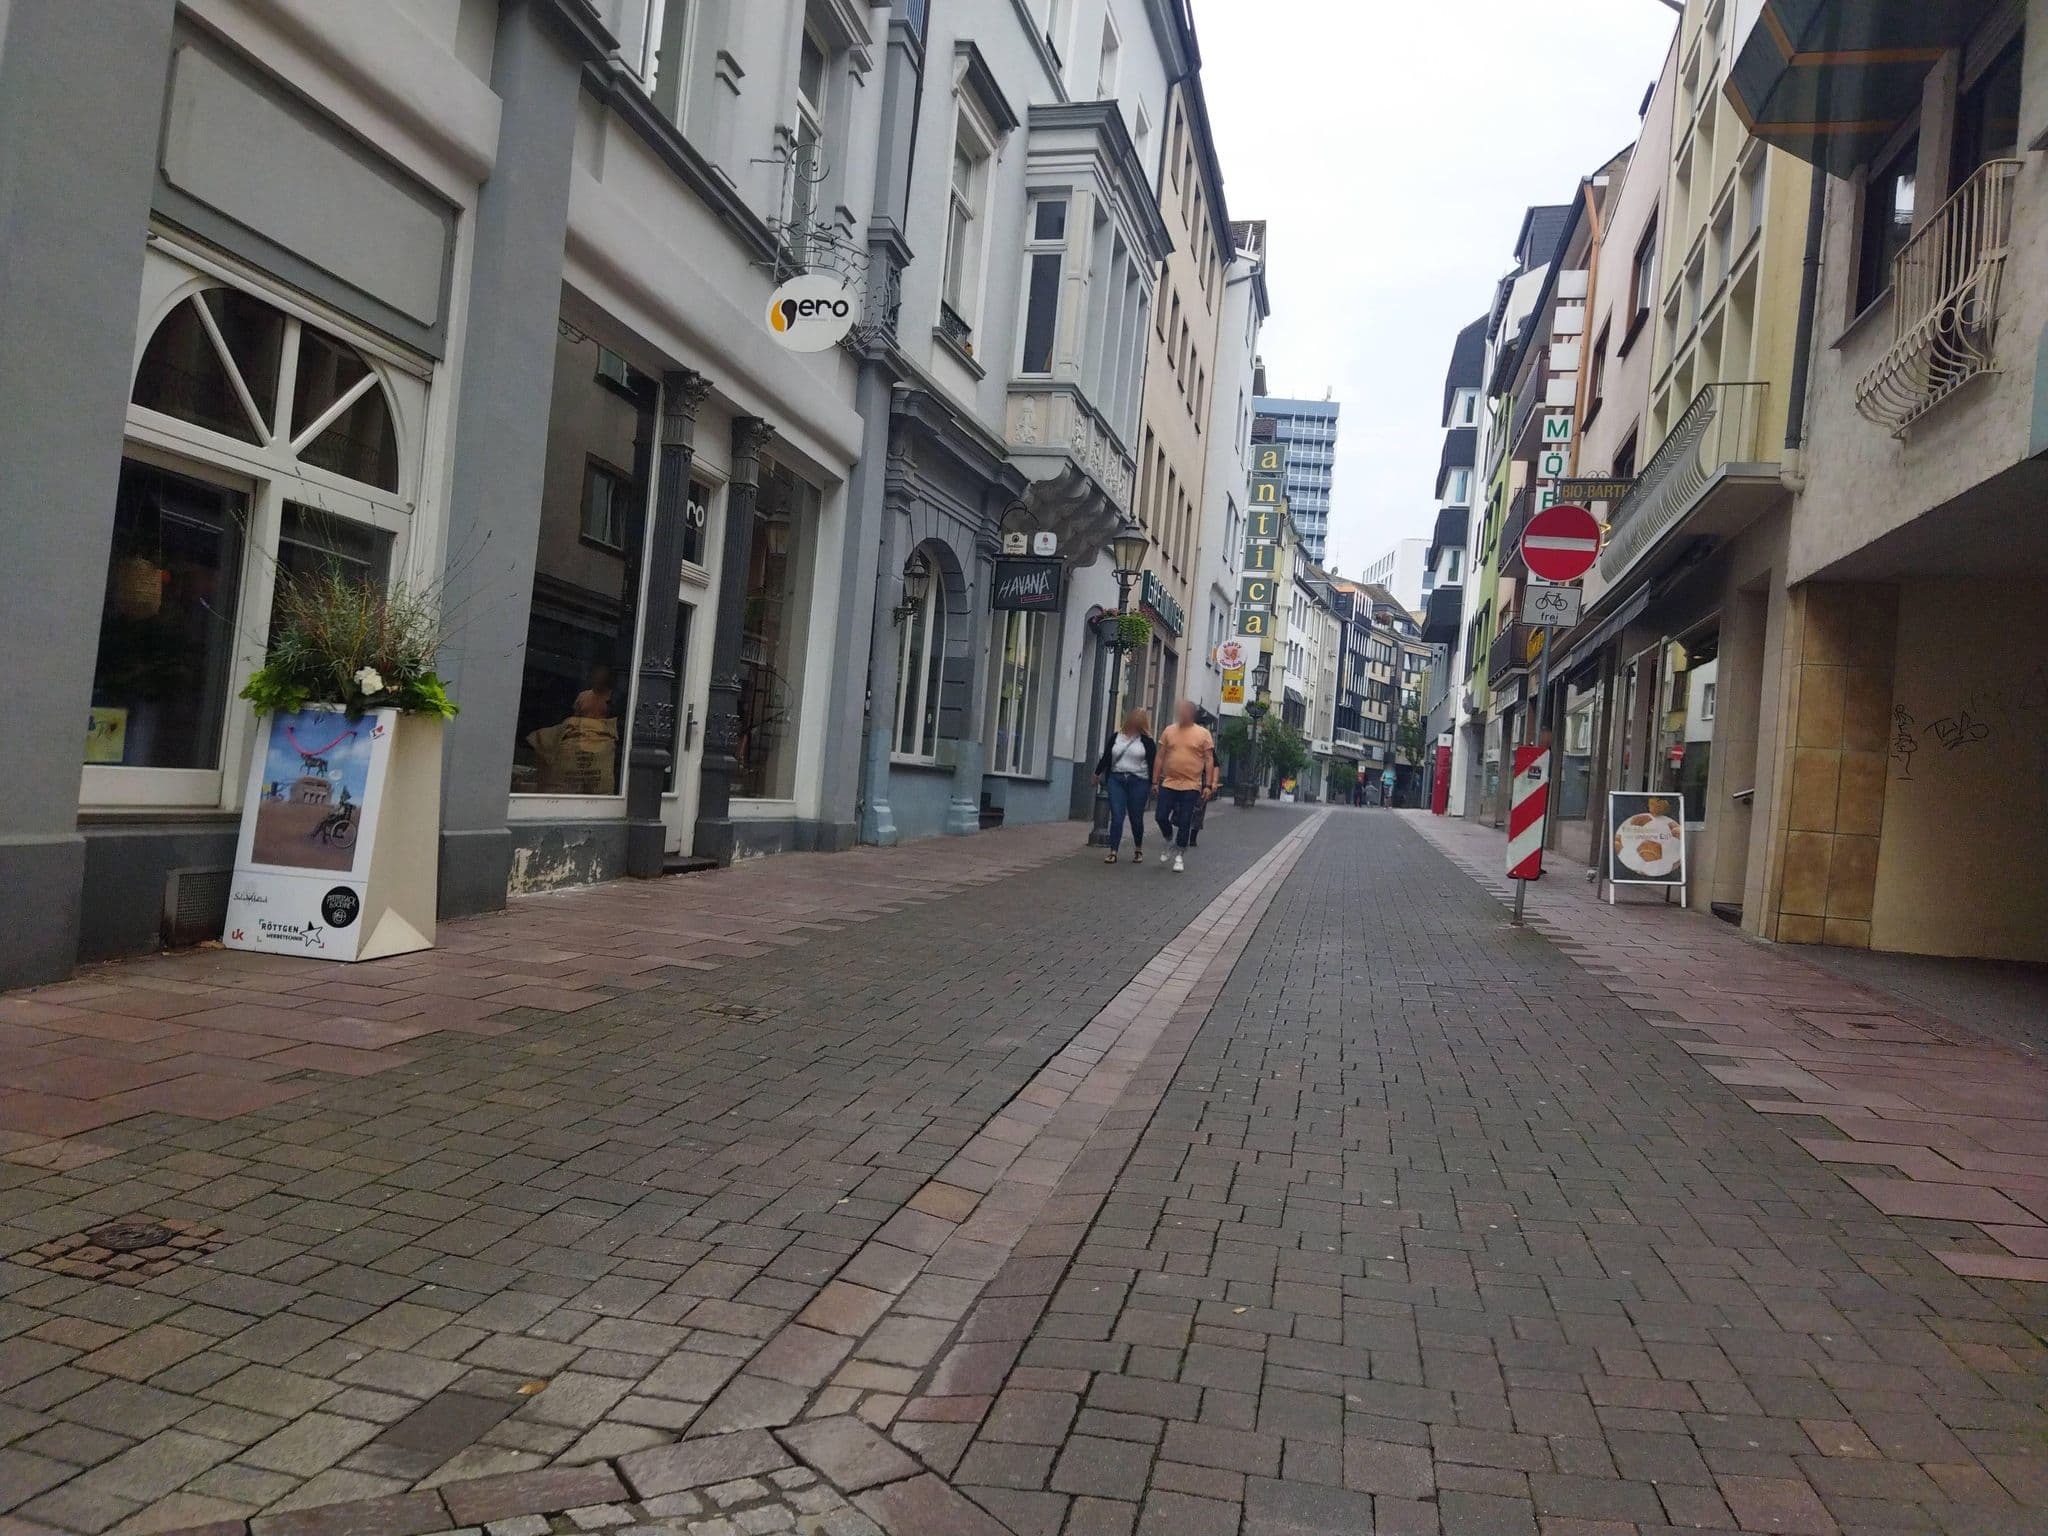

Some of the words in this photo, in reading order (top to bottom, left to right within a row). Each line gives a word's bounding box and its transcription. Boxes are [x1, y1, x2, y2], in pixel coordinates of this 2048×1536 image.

[1245, 450, 1278, 635] antica
[997, 570, 1050, 599] HAVANA
[1541, 610, 1558, 624] frei
[261, 920, 299, 933] RÖTTGEN
